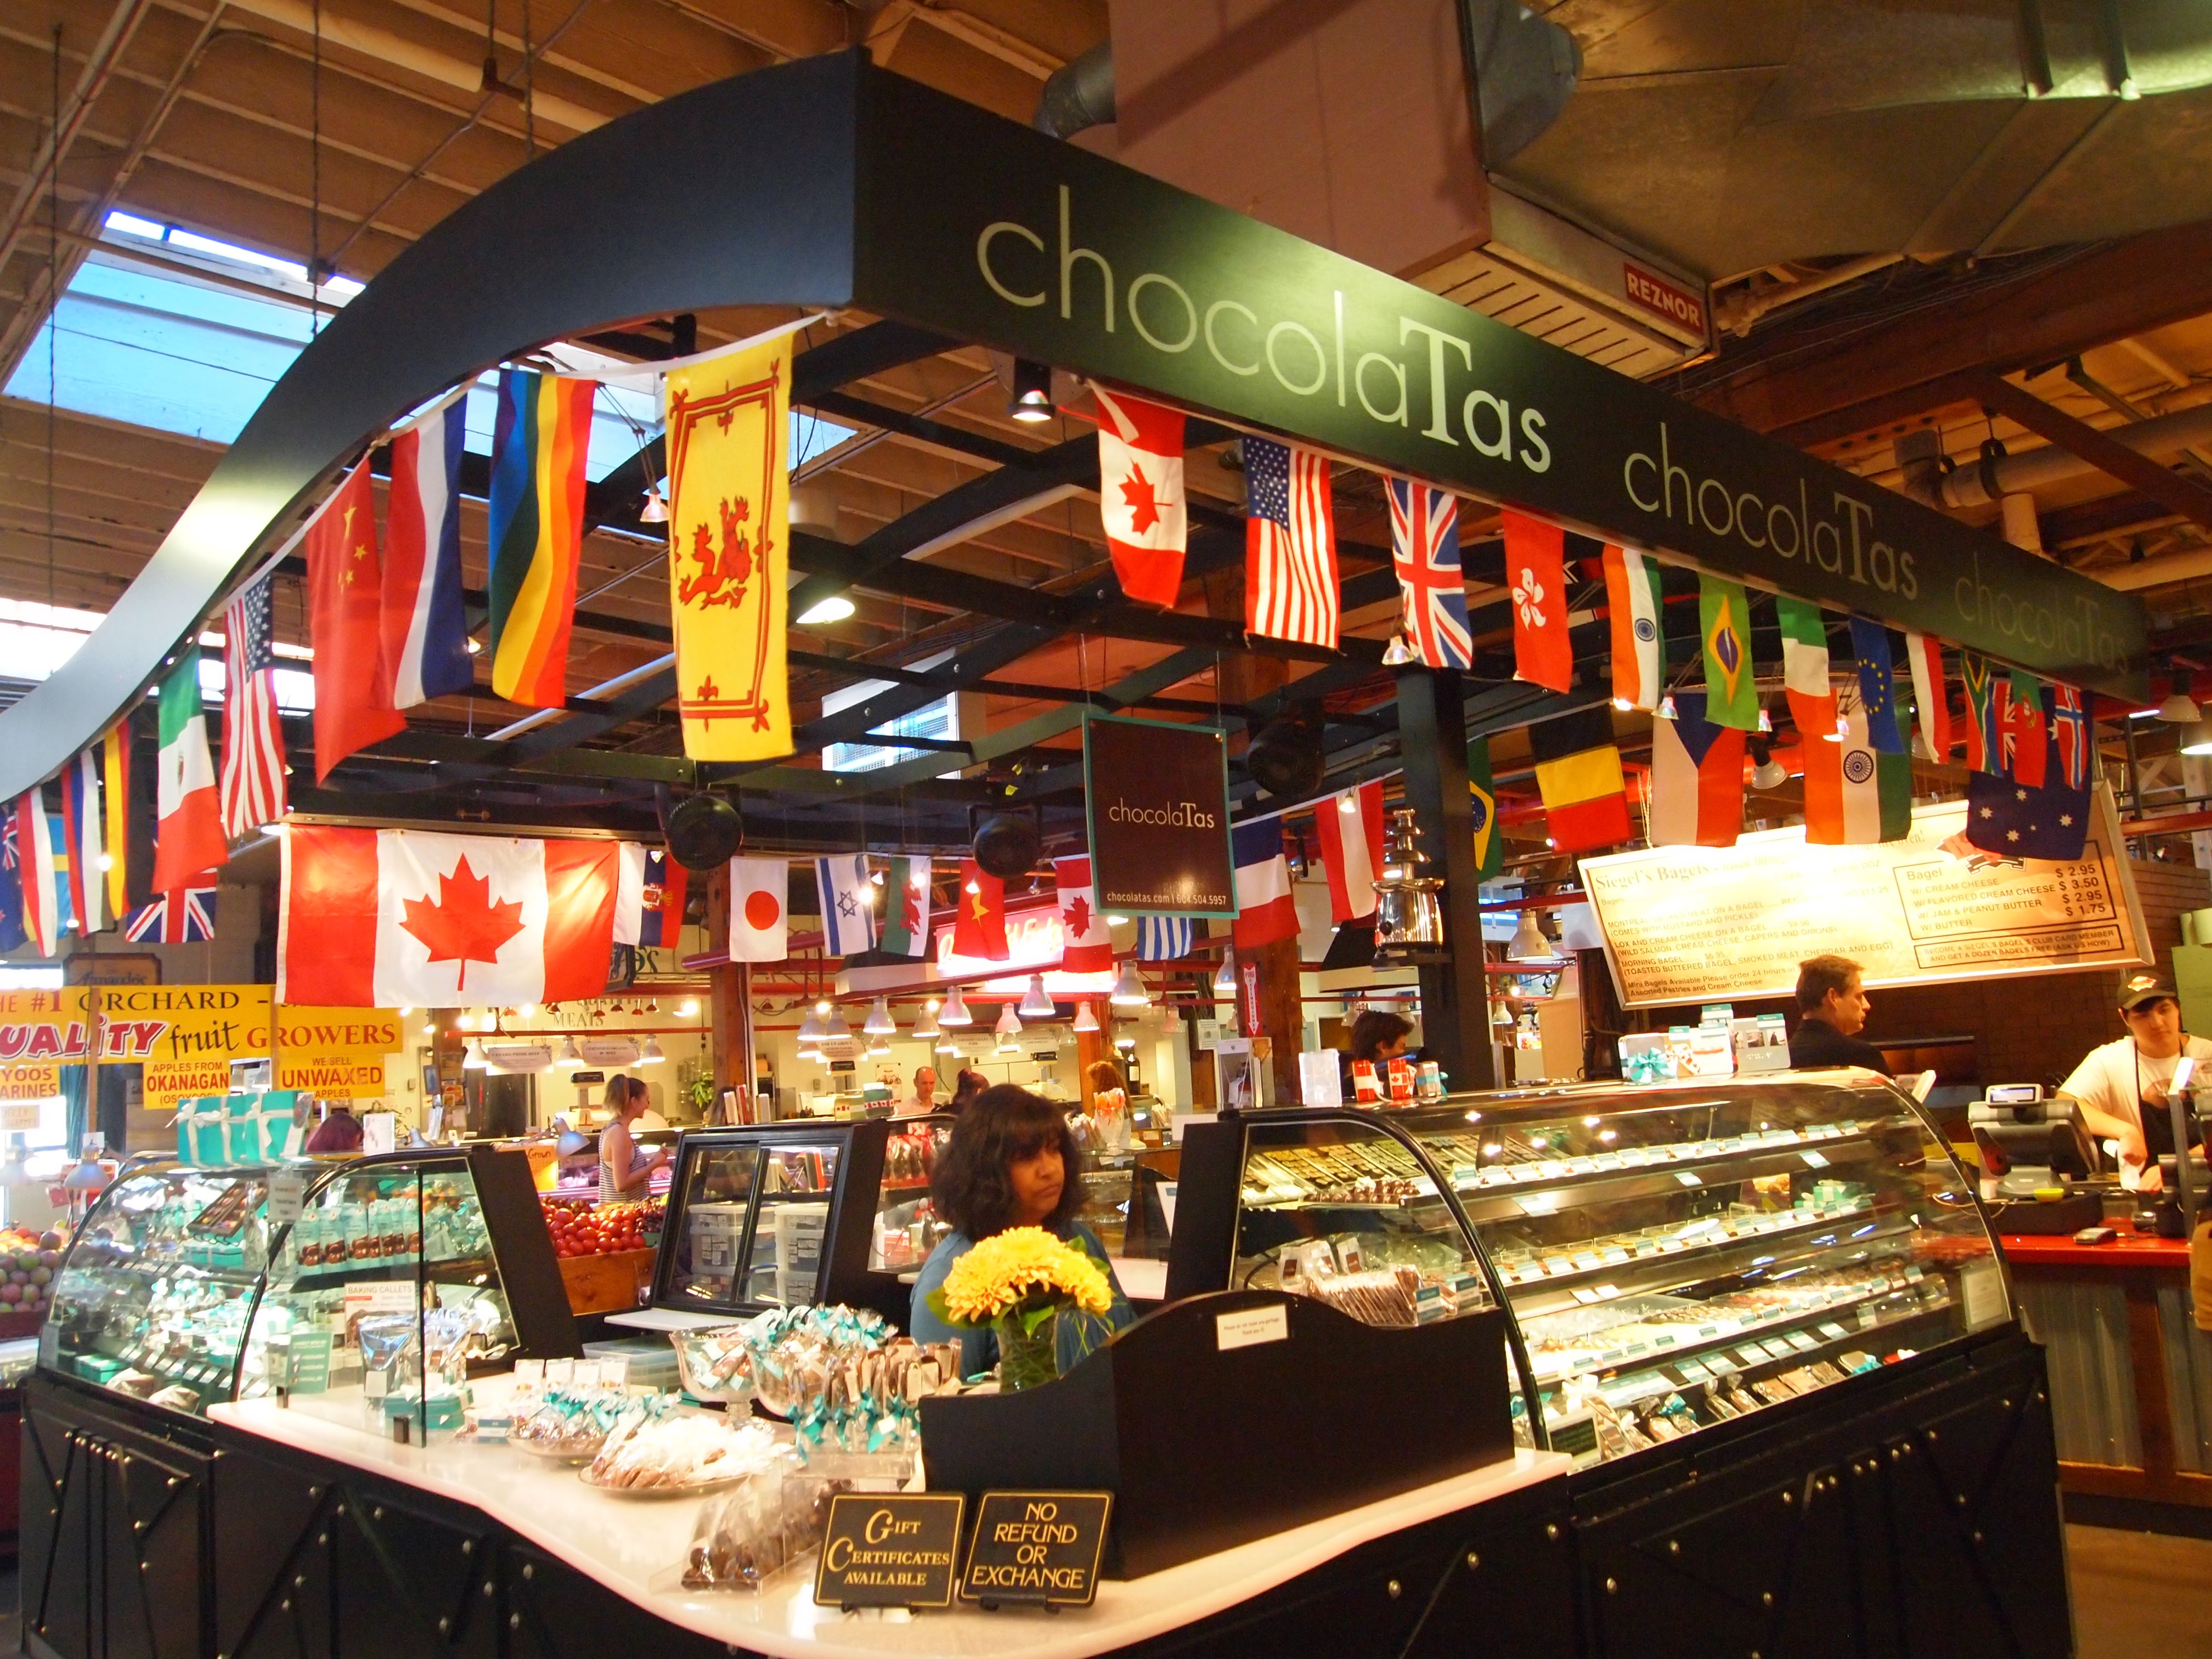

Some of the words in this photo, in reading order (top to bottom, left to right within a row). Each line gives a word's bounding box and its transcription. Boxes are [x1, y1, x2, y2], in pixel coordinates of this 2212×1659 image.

[1626, 272, 1702, 329] REZNOR
[977, 184, 1551, 473] chocolaTas
[1623, 422, 1918, 600] chocolaTas
[1955, 551, 2129, 675] chocolaTas
[1109, 797, 1215, 828] chocolaTas
[1595, 869, 1652, 890] Siegel's
[1656, 862, 1710, 881] Bagels
[1906, 867, 1943, 881] Bagel
[1925, 883, 1959, 893] CREAM
[1961, 878, 2000, 889] CHEESE
[2055, 867, 2064, 878] $
[2068, 864, 2096, 877] 2.95
[1107, 891, 1170, 904] chocolatas.com
[1176, 894, 1226, 905] 604.504.5957
[1927, 893, 1977, 905] FLAVORED
[1980, 889, 2014, 899] CREAM
[2016, 884, 2056, 896] CHEESE
[2058, 881, 2067, 891] $
[2071, 877, 2099, 889] 3.50
[1608, 917, 1648, 928] MONTREA
[1688, 908, 1710, 918] MEAT
[1713, 906, 1725, 915] ON
[1736, 901, 1764, 911] BAGEL
[1932, 909, 1951, 918] JAM
[1962, 904, 2001, 914] PEANUT
[2004, 899, 2042, 910] BUTTER
[2062, 894, 2070, 904] $
[2074, 890, 2103, 902] 2.95
[1611, 927, 1640, 938] (COMES
[1641, 924, 1661, 933] WITH
[1663, 919, 1703, 930] MUSTARD
[1705, 916, 1723, 925] AND
[1935, 918, 1973, 930] BUTTER
[2065, 906, 2074, 917] $
[2078, 902, 2106, 915] 1.75
[1614, 940, 1629, 949] LOX
[1632, 938, 1647, 947] AND
[1650, 935, 1678, 945] CREAM
[1679, 930, 1713, 941] CHEESE
[1739, 924, 1767, 933] BAGEL
[1618, 947, 1639, 957] (WILD
[1675, 940, 1705, 950] CREAM
[1745, 932, 1779, 942] CAPERS
[1802, 926, 1837, 935] ONIONS)
[1925, 945, 1956, 955] BECOME
[2055, 934, 2077, 942] CARD
[2078, 929, 2114, 940] MEMBER
[1623, 966, 1661, 977] (TOASTED
[1663, 962, 1703, 973] BUTTERED
[1737, 953, 1774, 964] SMOKED
[1804, 947, 1846, 957] CHEDDAR
[1870, 941, 1893, 952] EGG)
[1930, 953, 1946, 962] AND
[1972, 948, 1997, 957] DOZEN
[1999, 946, 2030, 955] BAGELS
[2032, 944, 2051, 952] FREE
[2074, 941, 2086, 949] US
[2087, 939, 2111, 948] HOW)
[1621, 957, 1656, 968] MORNING
[1658, 956, 1684, 964] BAGEL
[1630, 986, 1661, 996] Assorted
[1663, 985, 1691, 994] Pastries
[1692, 983, 1706, 991] and
[1708, 981, 1733, 990] Cream
[1734, 979, 1763, 988] Cheese
[1644, 978, 1668, 989] Bagels
[1669, 977, 1701, 985] Available
[1702, 974, 1728, 982] Please
[1729, 972, 1749, 980] order
[30, 991, 63, 1012] #1
[78, 991, 239, 1011] ORCHARD
[553, 1012, 603, 1028] MEATS
[169, 1020, 240, 1059] fruit
[247, 1023, 395, 1048] GROWERS
[152, 1062, 193, 1074] APPLES
[195, 1061, 223, 1071] FROM
[312, 1057, 328, 1065] WE
[329, 1056, 352, 1065] SELL
[3, 1068, 53, 1082] YOOS
[146, 1072, 230, 1093] OKANAGAN
[281, 1067, 382, 1088] UNWAXED
[0, 1083, 58, 1099] ARINES
[314, 1089, 351, 1098] APPLES
[348, 1286, 377, 1294] BAKING
[379, 1285, 412, 1293] CALLETS
[1024, 1502, 1057, 1522] NO
[994, 1523, 1078, 1544] REFUND
[827, 1537, 950, 1572] CERTIFICATES
[1016, 1544, 1047, 1564] OR
[844, 1572, 927, 1586] AVAILABLE
[970, 1565, 1085, 1589] EXCHANGE
